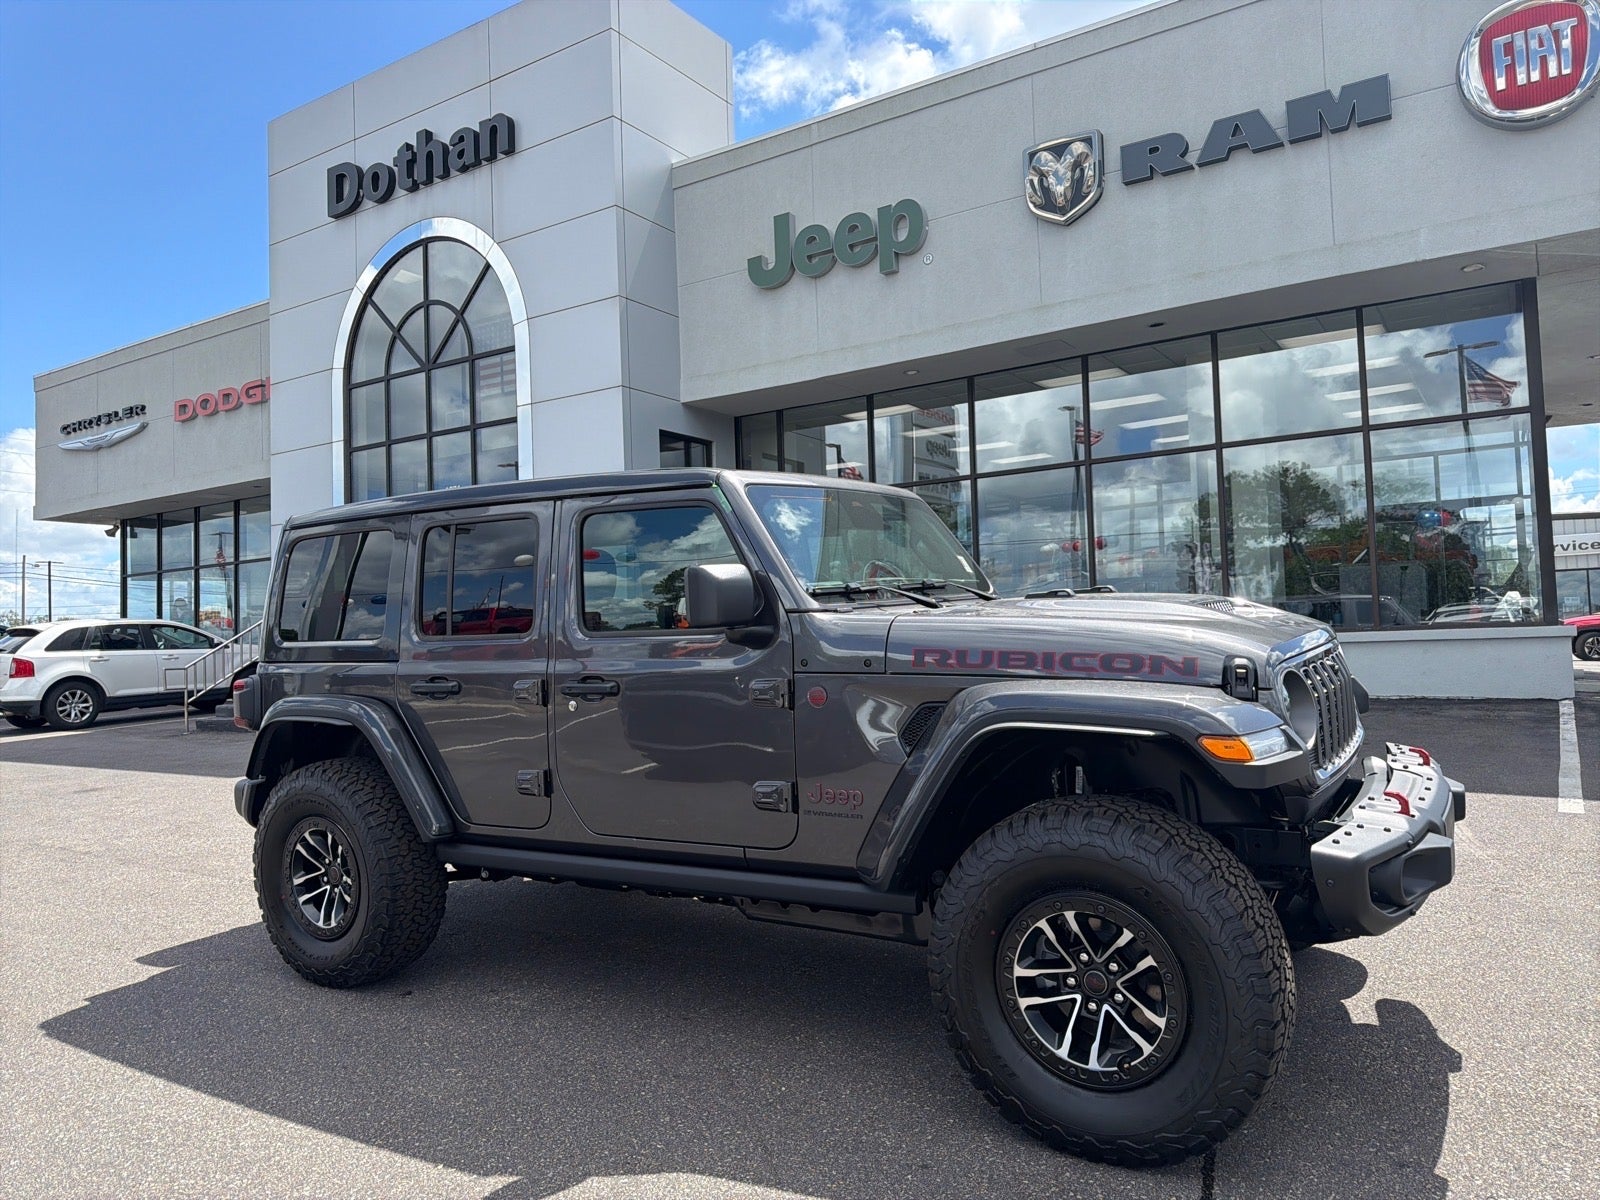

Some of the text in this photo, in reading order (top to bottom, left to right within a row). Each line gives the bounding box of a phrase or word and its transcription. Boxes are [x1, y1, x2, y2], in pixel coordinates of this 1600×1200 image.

[1491, 17, 1578, 92] FIAT
[1119, 73, 1392, 186] RAM
[327, 112, 516, 219] Dothan
[747, 198, 929, 289] Jeep
[59, 403, 148, 436] CHRYSLER
[911, 647, 1200, 677] RUBICON
[806, 782, 865, 811] Jeep
[812, 809, 864, 820] WRANGLER
